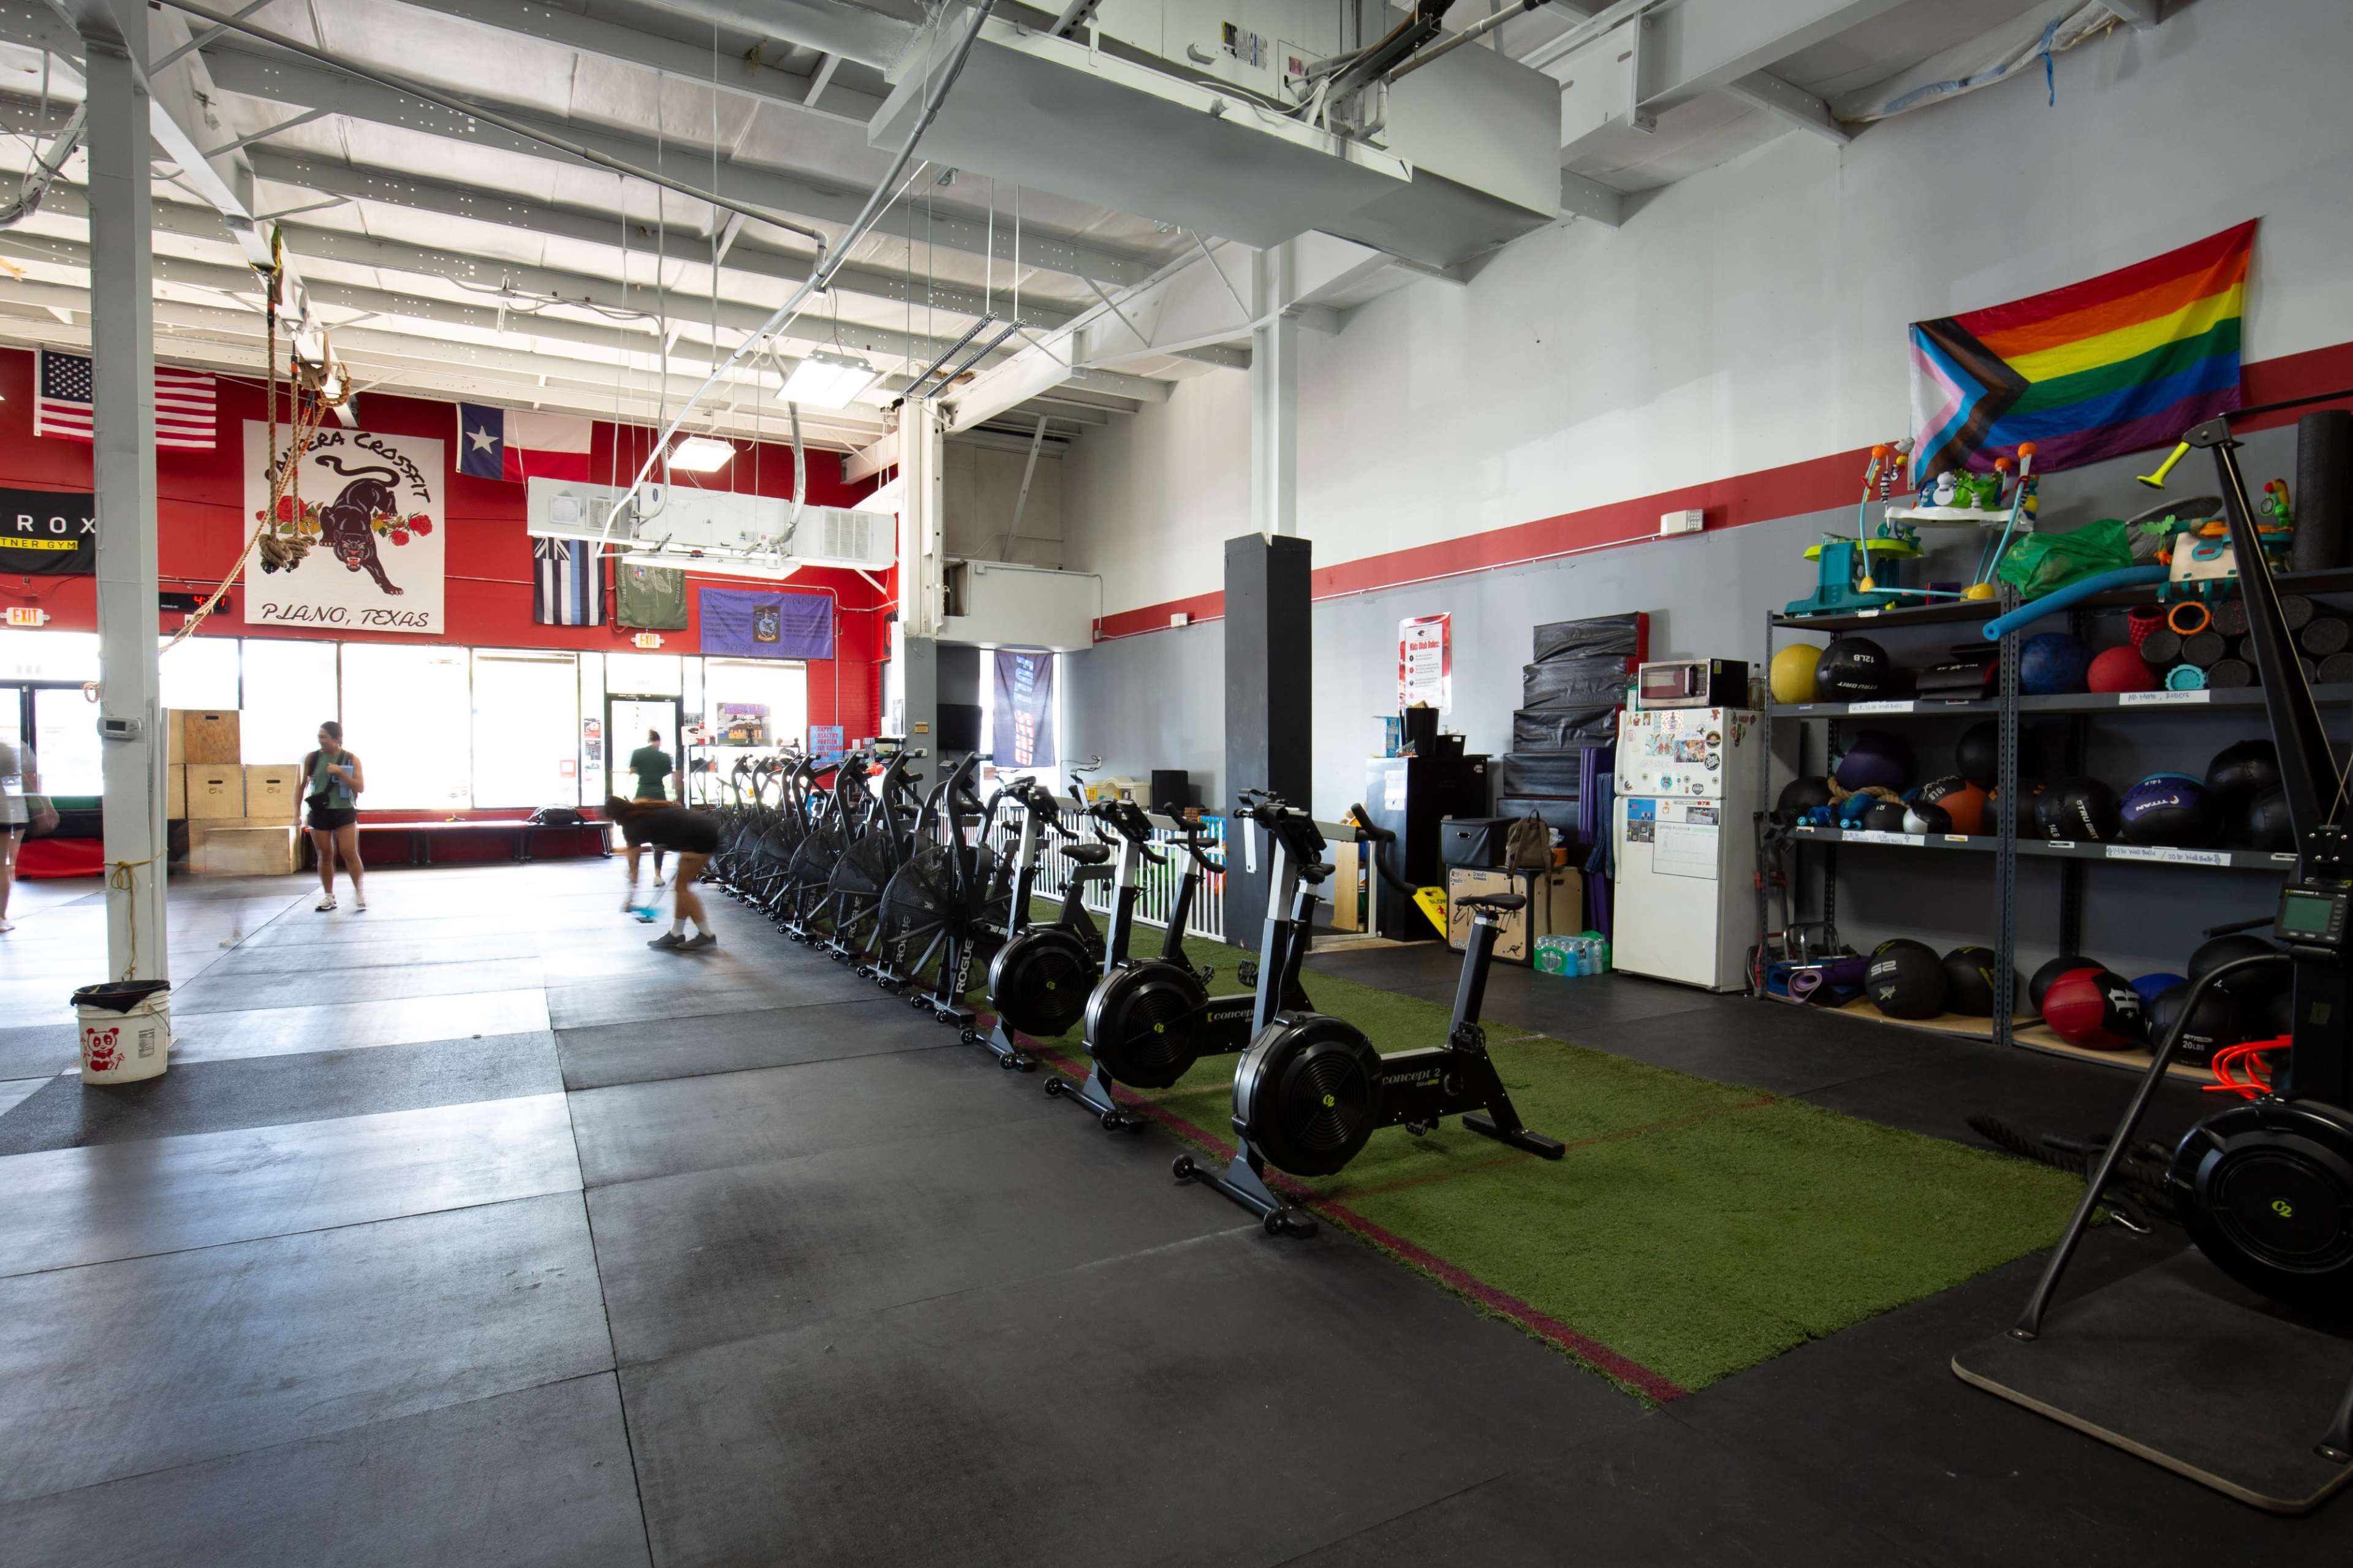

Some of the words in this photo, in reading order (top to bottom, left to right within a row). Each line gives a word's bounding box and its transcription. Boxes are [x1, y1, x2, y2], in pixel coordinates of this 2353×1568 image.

[354, 433, 431, 503] CROSSFIT
[17, 514, 96, 534] ROX
[1, 538, 39, 548] TNER
[13, 608, 38, 623] EXIT
[262, 604, 352, 625] PLANO,
[362, 610, 429, 627] TEXAS
[640, 634, 657, 646] EXIT
[726, 644, 752, 653] 2024
[778, 646, 812, 656] OPEN
[1854, 654, 1875, 663] 12LB
[1014, 655, 1034, 704] FULL
[1015, 710, 1034, 767] SEND
[2135, 799, 2169, 811] TITAN
[895, 915, 911, 963] ROUE
[956, 937, 974, 993] ROGUE
[1214, 1009, 1254, 1020] concep
[1382, 1069, 1431, 1086] concept
[1434, 1067, 1441, 1077] 2
